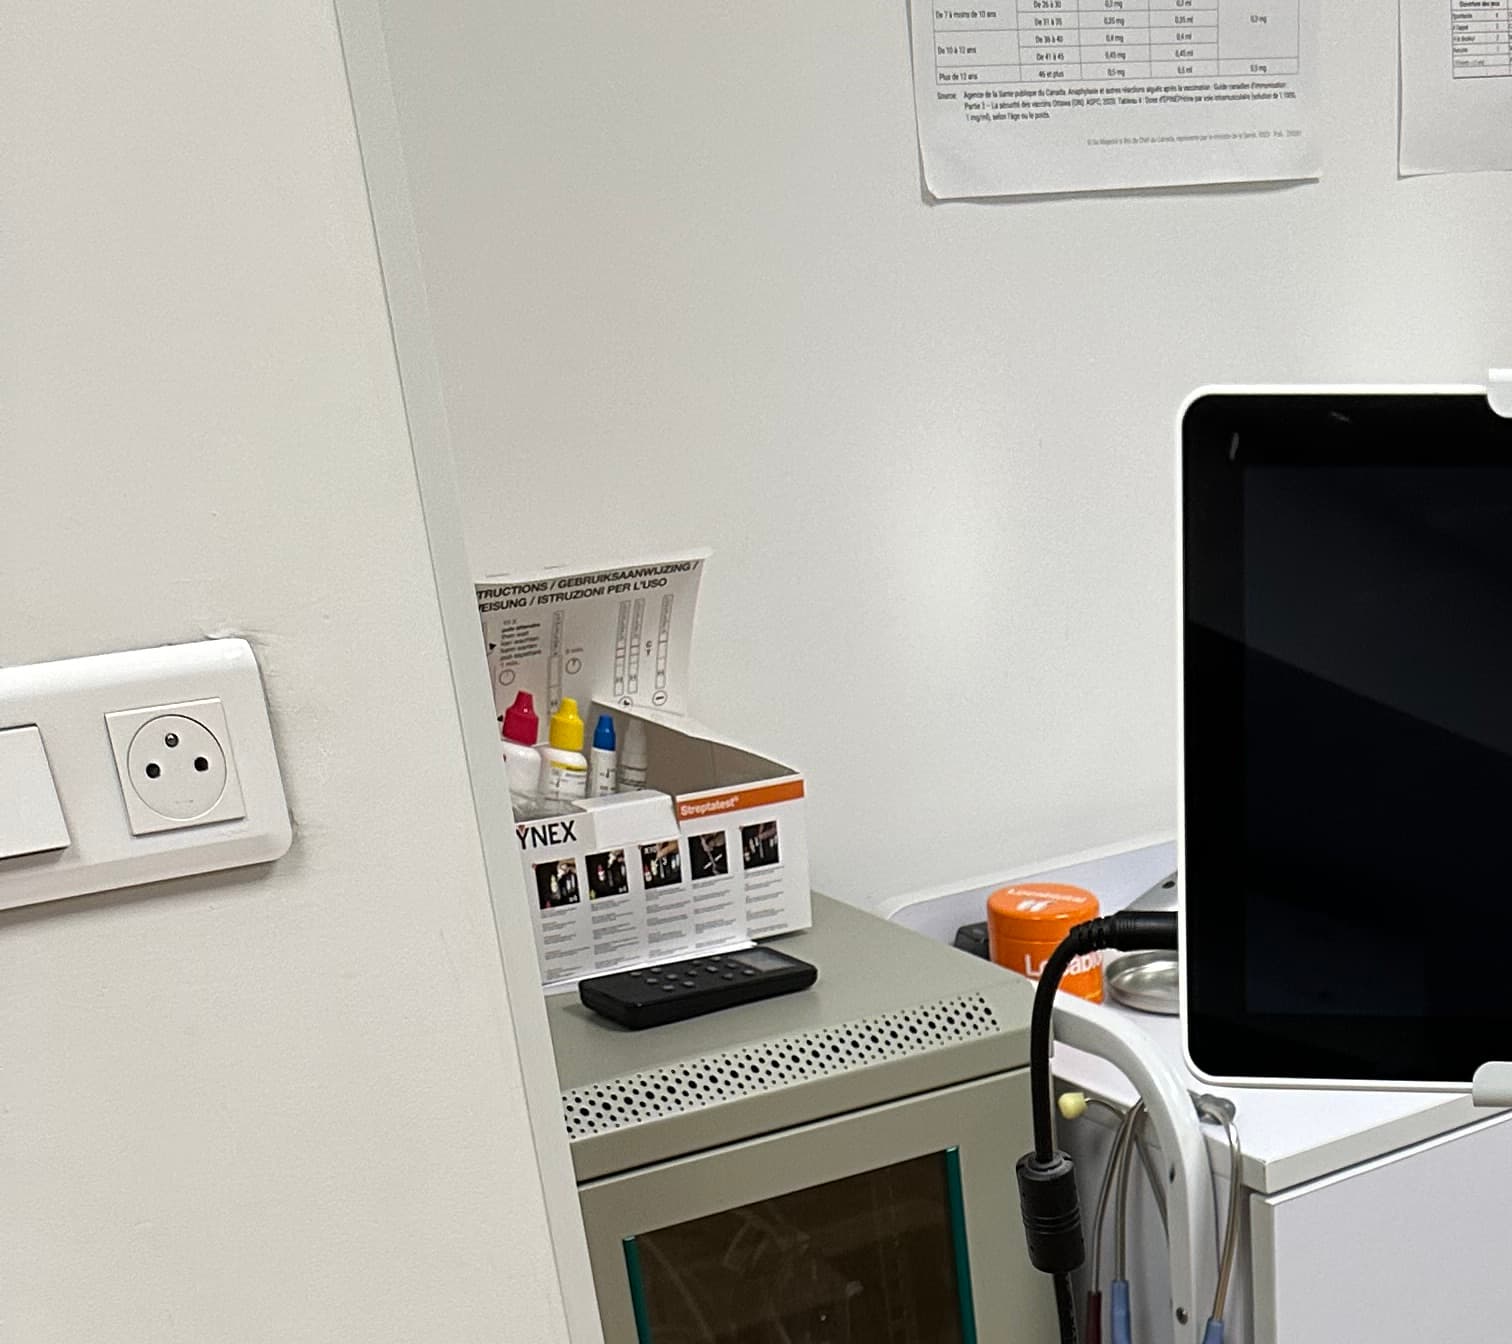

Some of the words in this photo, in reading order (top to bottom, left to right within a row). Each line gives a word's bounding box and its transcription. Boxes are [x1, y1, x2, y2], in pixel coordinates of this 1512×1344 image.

[477, 582, 548, 600] TRUCTIONS
[558, 562, 690, 590] GEBRUIKSAANWIJZING
[537, 586, 605, 605] ISTRUZIONI
[607, 582, 630, 594] PER
[633, 578, 667, 591] L'USO
[516, 820, 577, 850] YNEX
